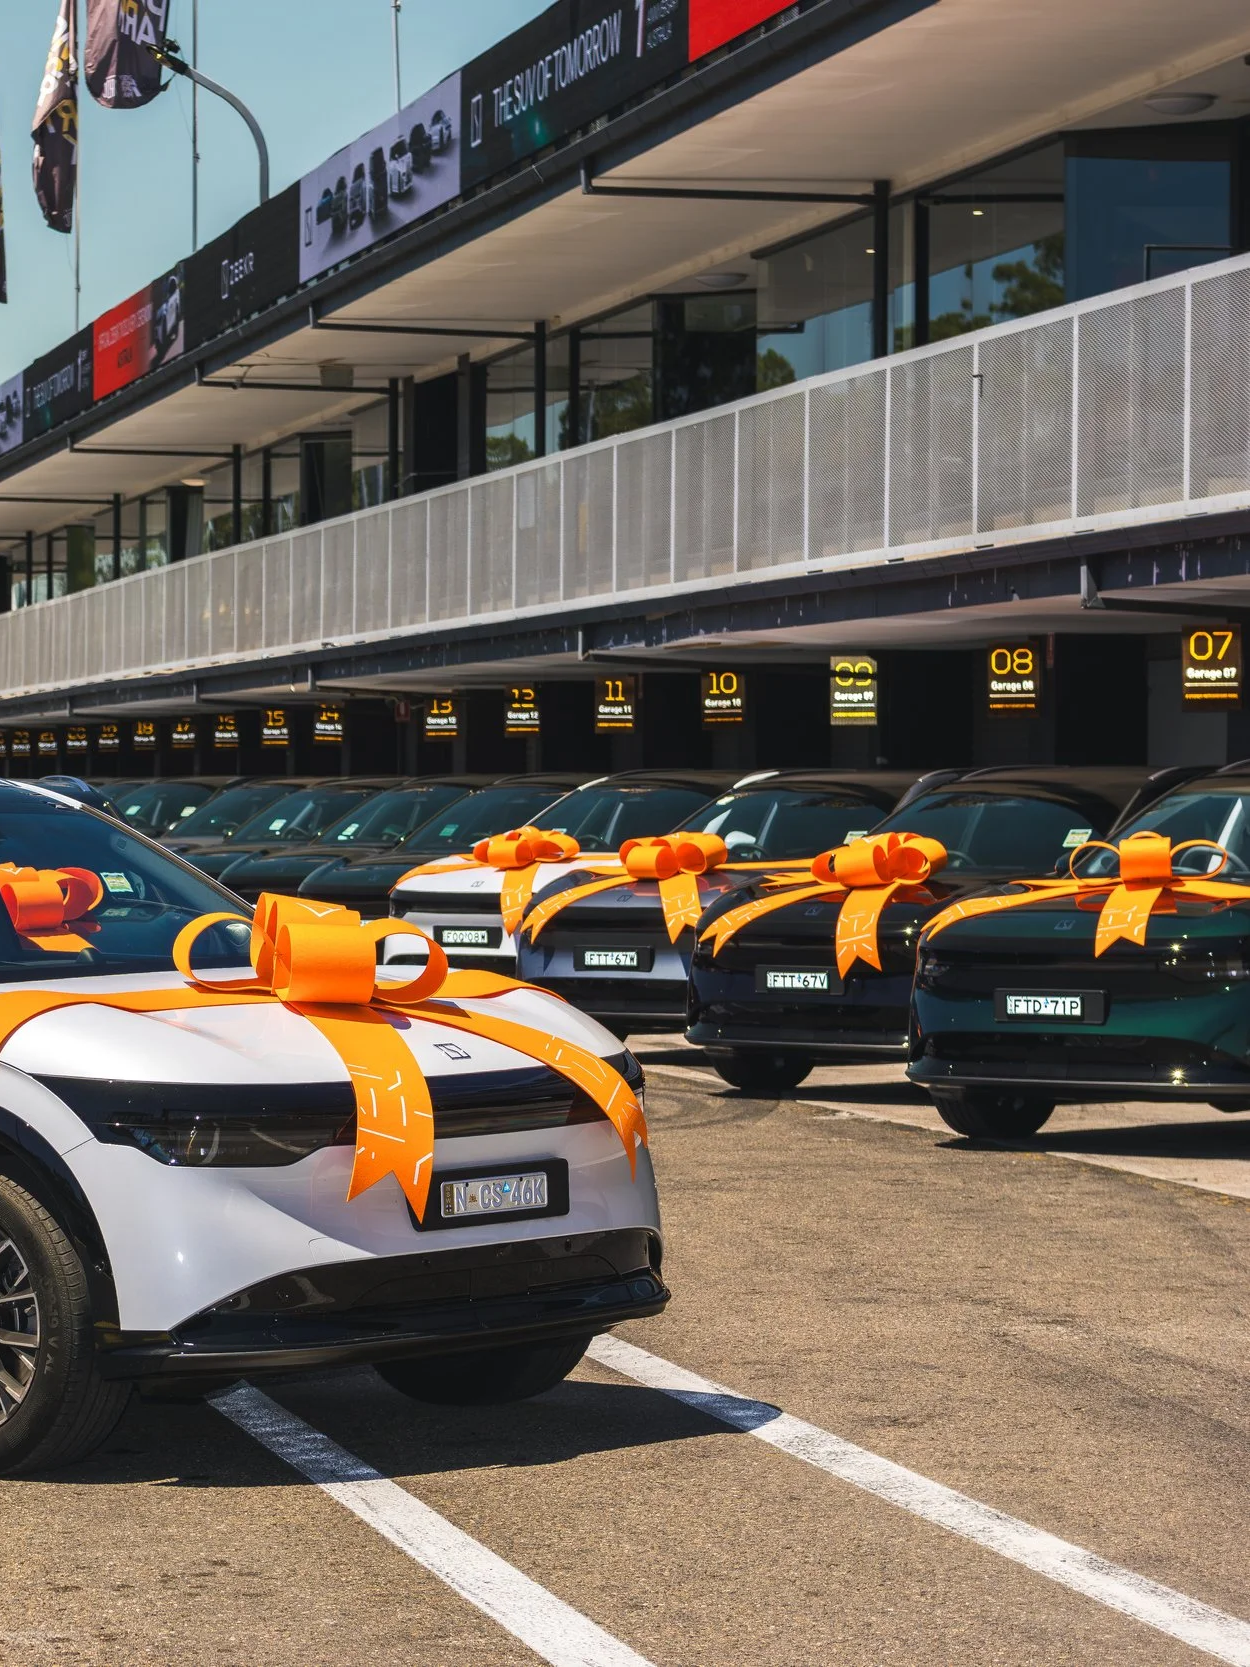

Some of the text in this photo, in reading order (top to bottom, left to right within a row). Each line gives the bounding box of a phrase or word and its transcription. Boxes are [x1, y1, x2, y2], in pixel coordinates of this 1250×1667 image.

[492, 79, 513, 127] THE
[513, 67, 536, 116] SUV
[537, 54, 553, 101] OF
[553, 9, 623, 91] TOMORROW
[1189, 631, 1233, 661] 07
[991, 648, 1033, 675] 08
[835, 661, 873, 687] 09
[1185, 667, 1237, 681] Garage 07
[708, 672, 737, 694] 10
[990, 680, 1034, 693] Garage 08
[604, 681, 626, 701] 11
[834, 691, 874, 703] Garage 09
[430, 700, 453, 714] 13
[598, 705, 632, 714] Garage 11
[704, 698, 741, 709] Garage 10
[266, 710, 285, 726] 15
[319, 703, 340, 721] 14
[507, 711, 531, 720] Garage
[427, 716, 448, 725] Garage
[135, 721, 154, 735] 18
[590, 953, 636, 965] FTT 67W
[773, 975, 827, 987] FTT 67V
[1014, 999, 1079, 1014] FTD 71P
[479, 1183, 503, 1210] CS
[509, 1178, 545, 1206] 46K
